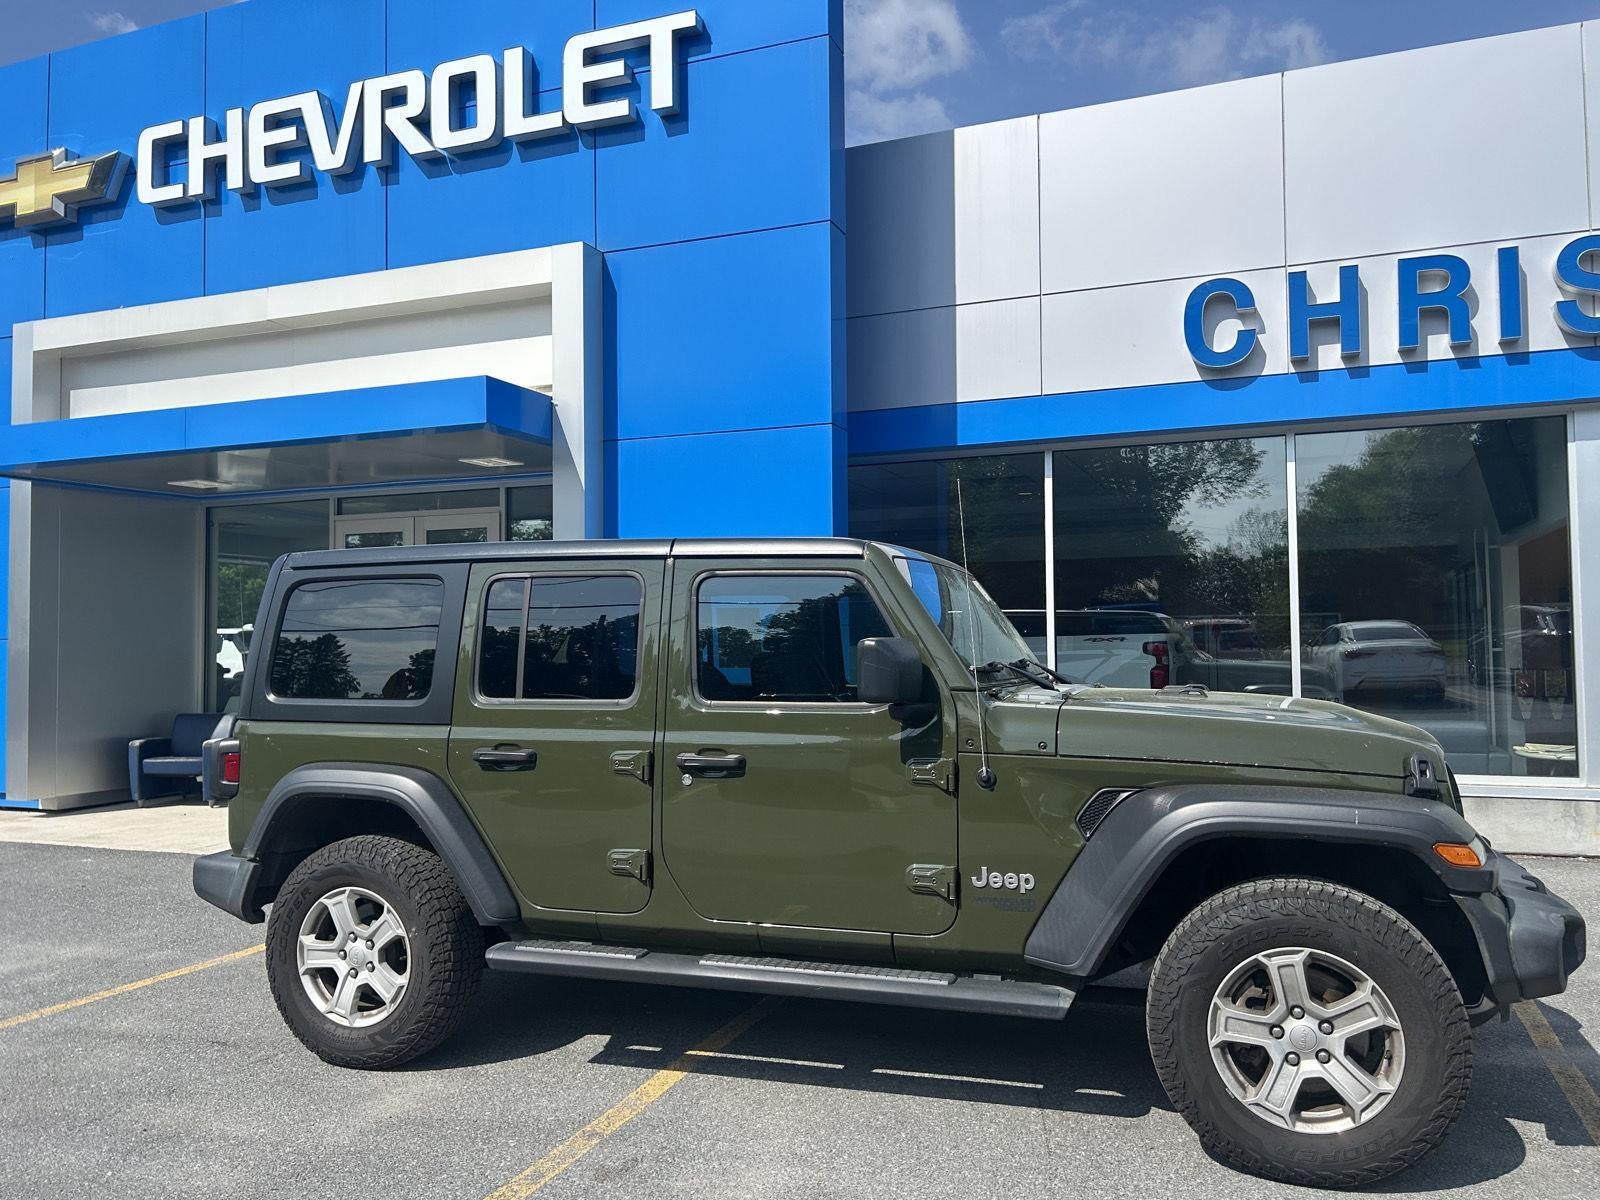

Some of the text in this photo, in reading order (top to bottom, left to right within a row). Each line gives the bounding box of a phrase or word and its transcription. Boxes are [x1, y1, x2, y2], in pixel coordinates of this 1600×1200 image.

[137, 9, 702, 205] CHEVROLET
[971, 866, 1035, 894] Jeep
[1218, 926, 1333, 961] COOPER
